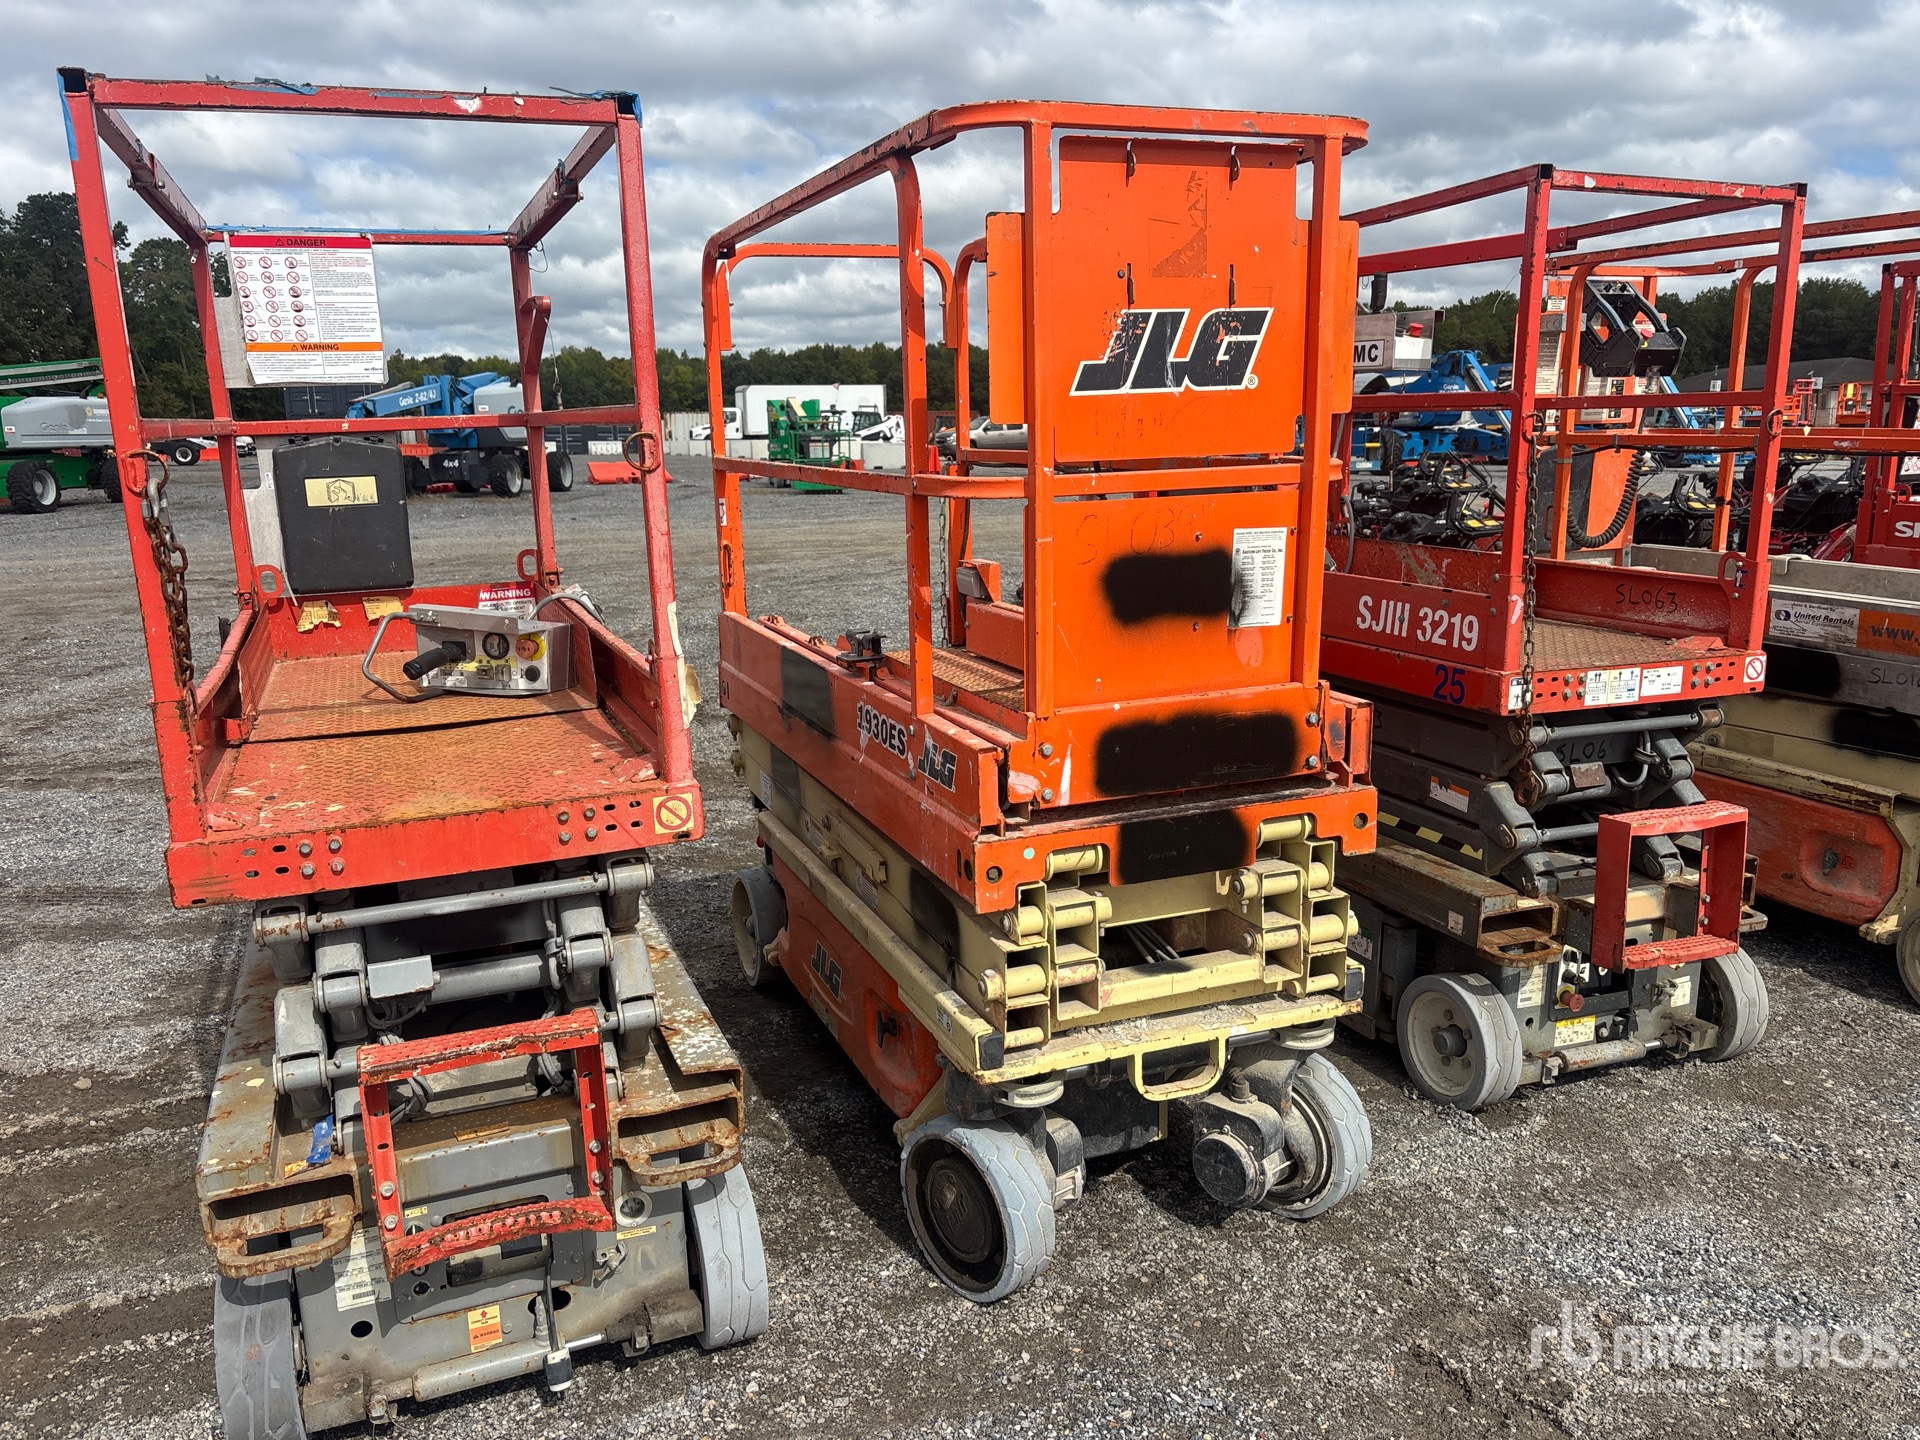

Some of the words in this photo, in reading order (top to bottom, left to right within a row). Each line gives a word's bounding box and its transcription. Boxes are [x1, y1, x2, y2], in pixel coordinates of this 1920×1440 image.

[286, 238, 326, 247] DANGER
[300, 343, 340, 351] WARNING
[399, 395, 414, 407] Genie
[443, 459, 460, 468] 4x4
[480, 588, 532, 600] WARNING
[1615, 583, 1678, 613] SL063
[1793, 611, 1823, 622] United
[1822, 615, 1856, 626] Rentals
[1416, 606, 1479, 652] 3219
[1432, 663, 1466, 705] 25
[857, 701, 908, 759] 1930ES
[916, 740, 958, 794] JLG
[811, 940, 843, 1001] JLG
[479, 1328, 500, 1338] WARNING
